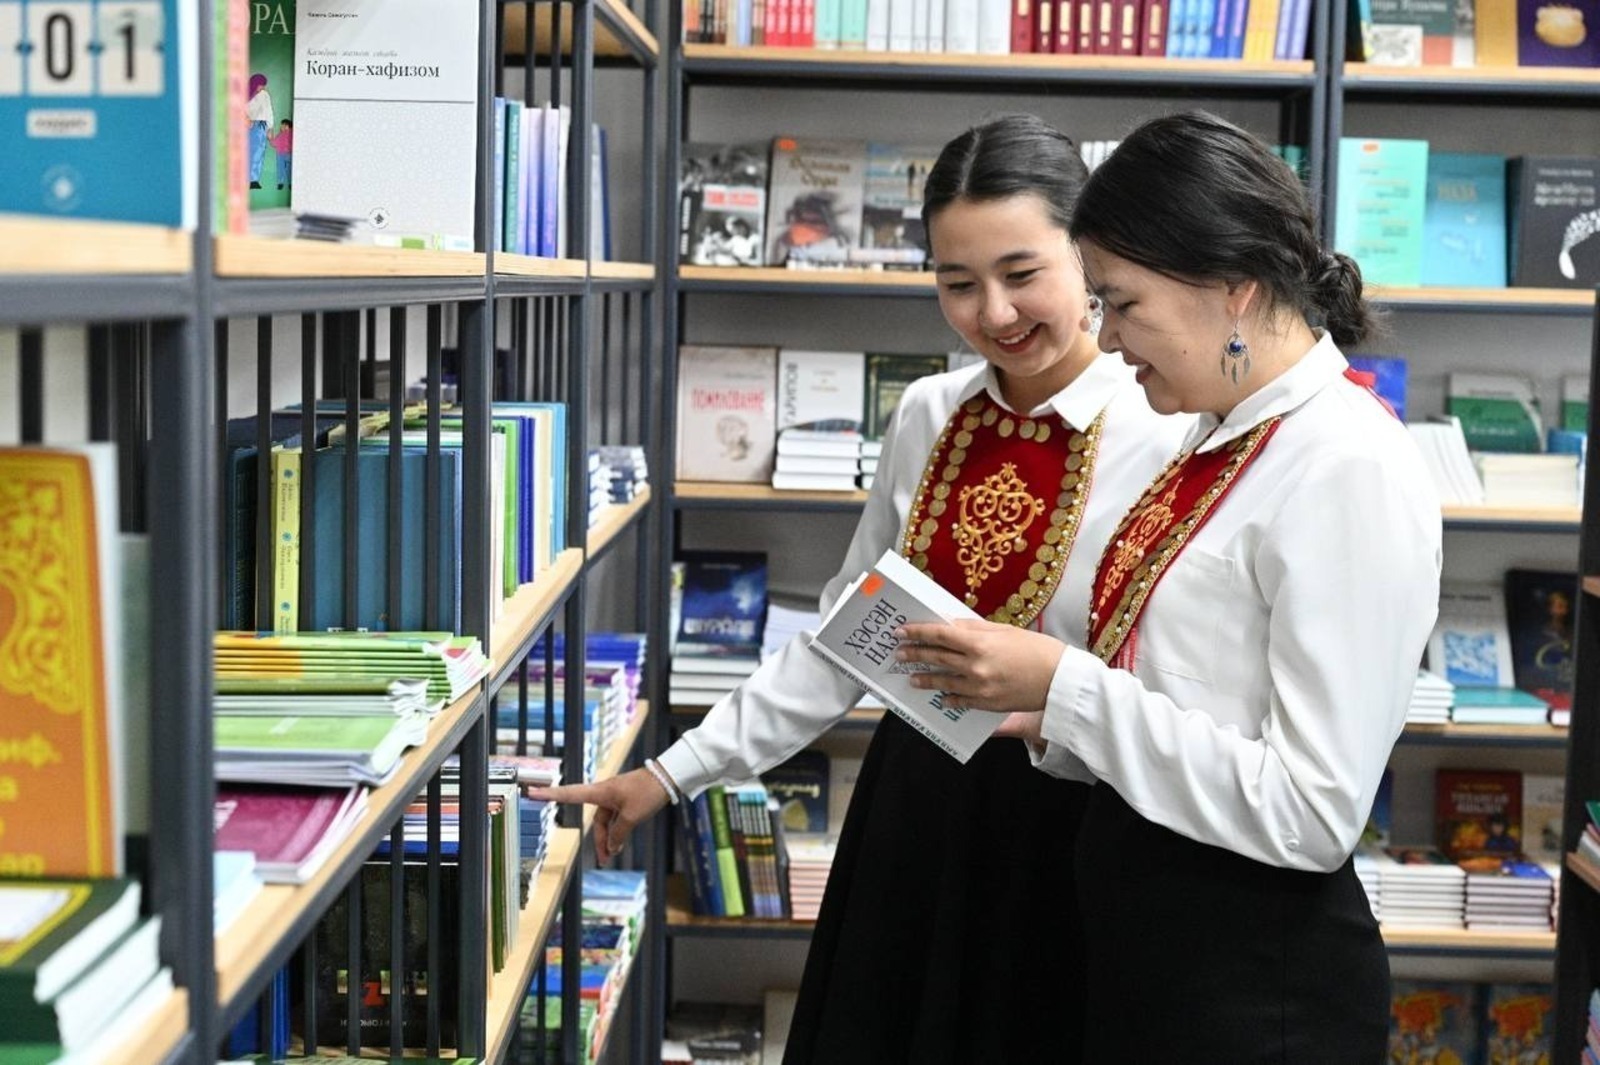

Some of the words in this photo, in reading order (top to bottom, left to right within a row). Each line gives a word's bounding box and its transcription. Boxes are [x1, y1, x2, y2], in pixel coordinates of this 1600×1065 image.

[306, 60, 440, 80] Коран-хафизом
[844, 599, 897, 655] ХӘСӘН
[864, 615, 907, 666] НАЗР
